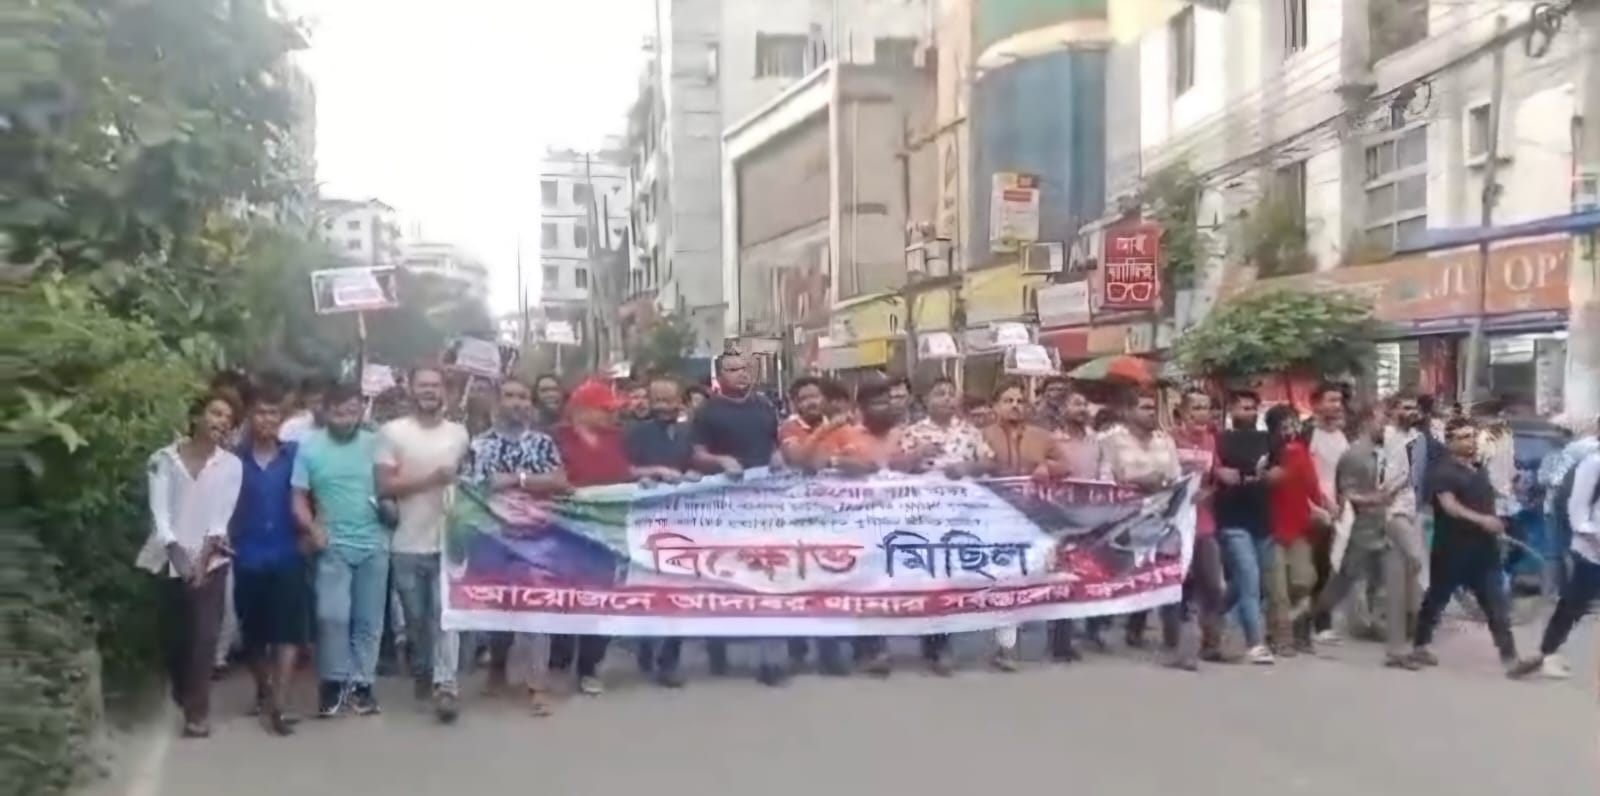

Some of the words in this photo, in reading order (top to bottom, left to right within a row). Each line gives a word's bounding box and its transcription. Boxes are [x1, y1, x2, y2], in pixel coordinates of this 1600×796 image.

[642, 531, 864, 581] বিক্ষোভ
[877, 529, 1033, 581] মিছিল
[463, 584, 656, 612] আয়োজনে
